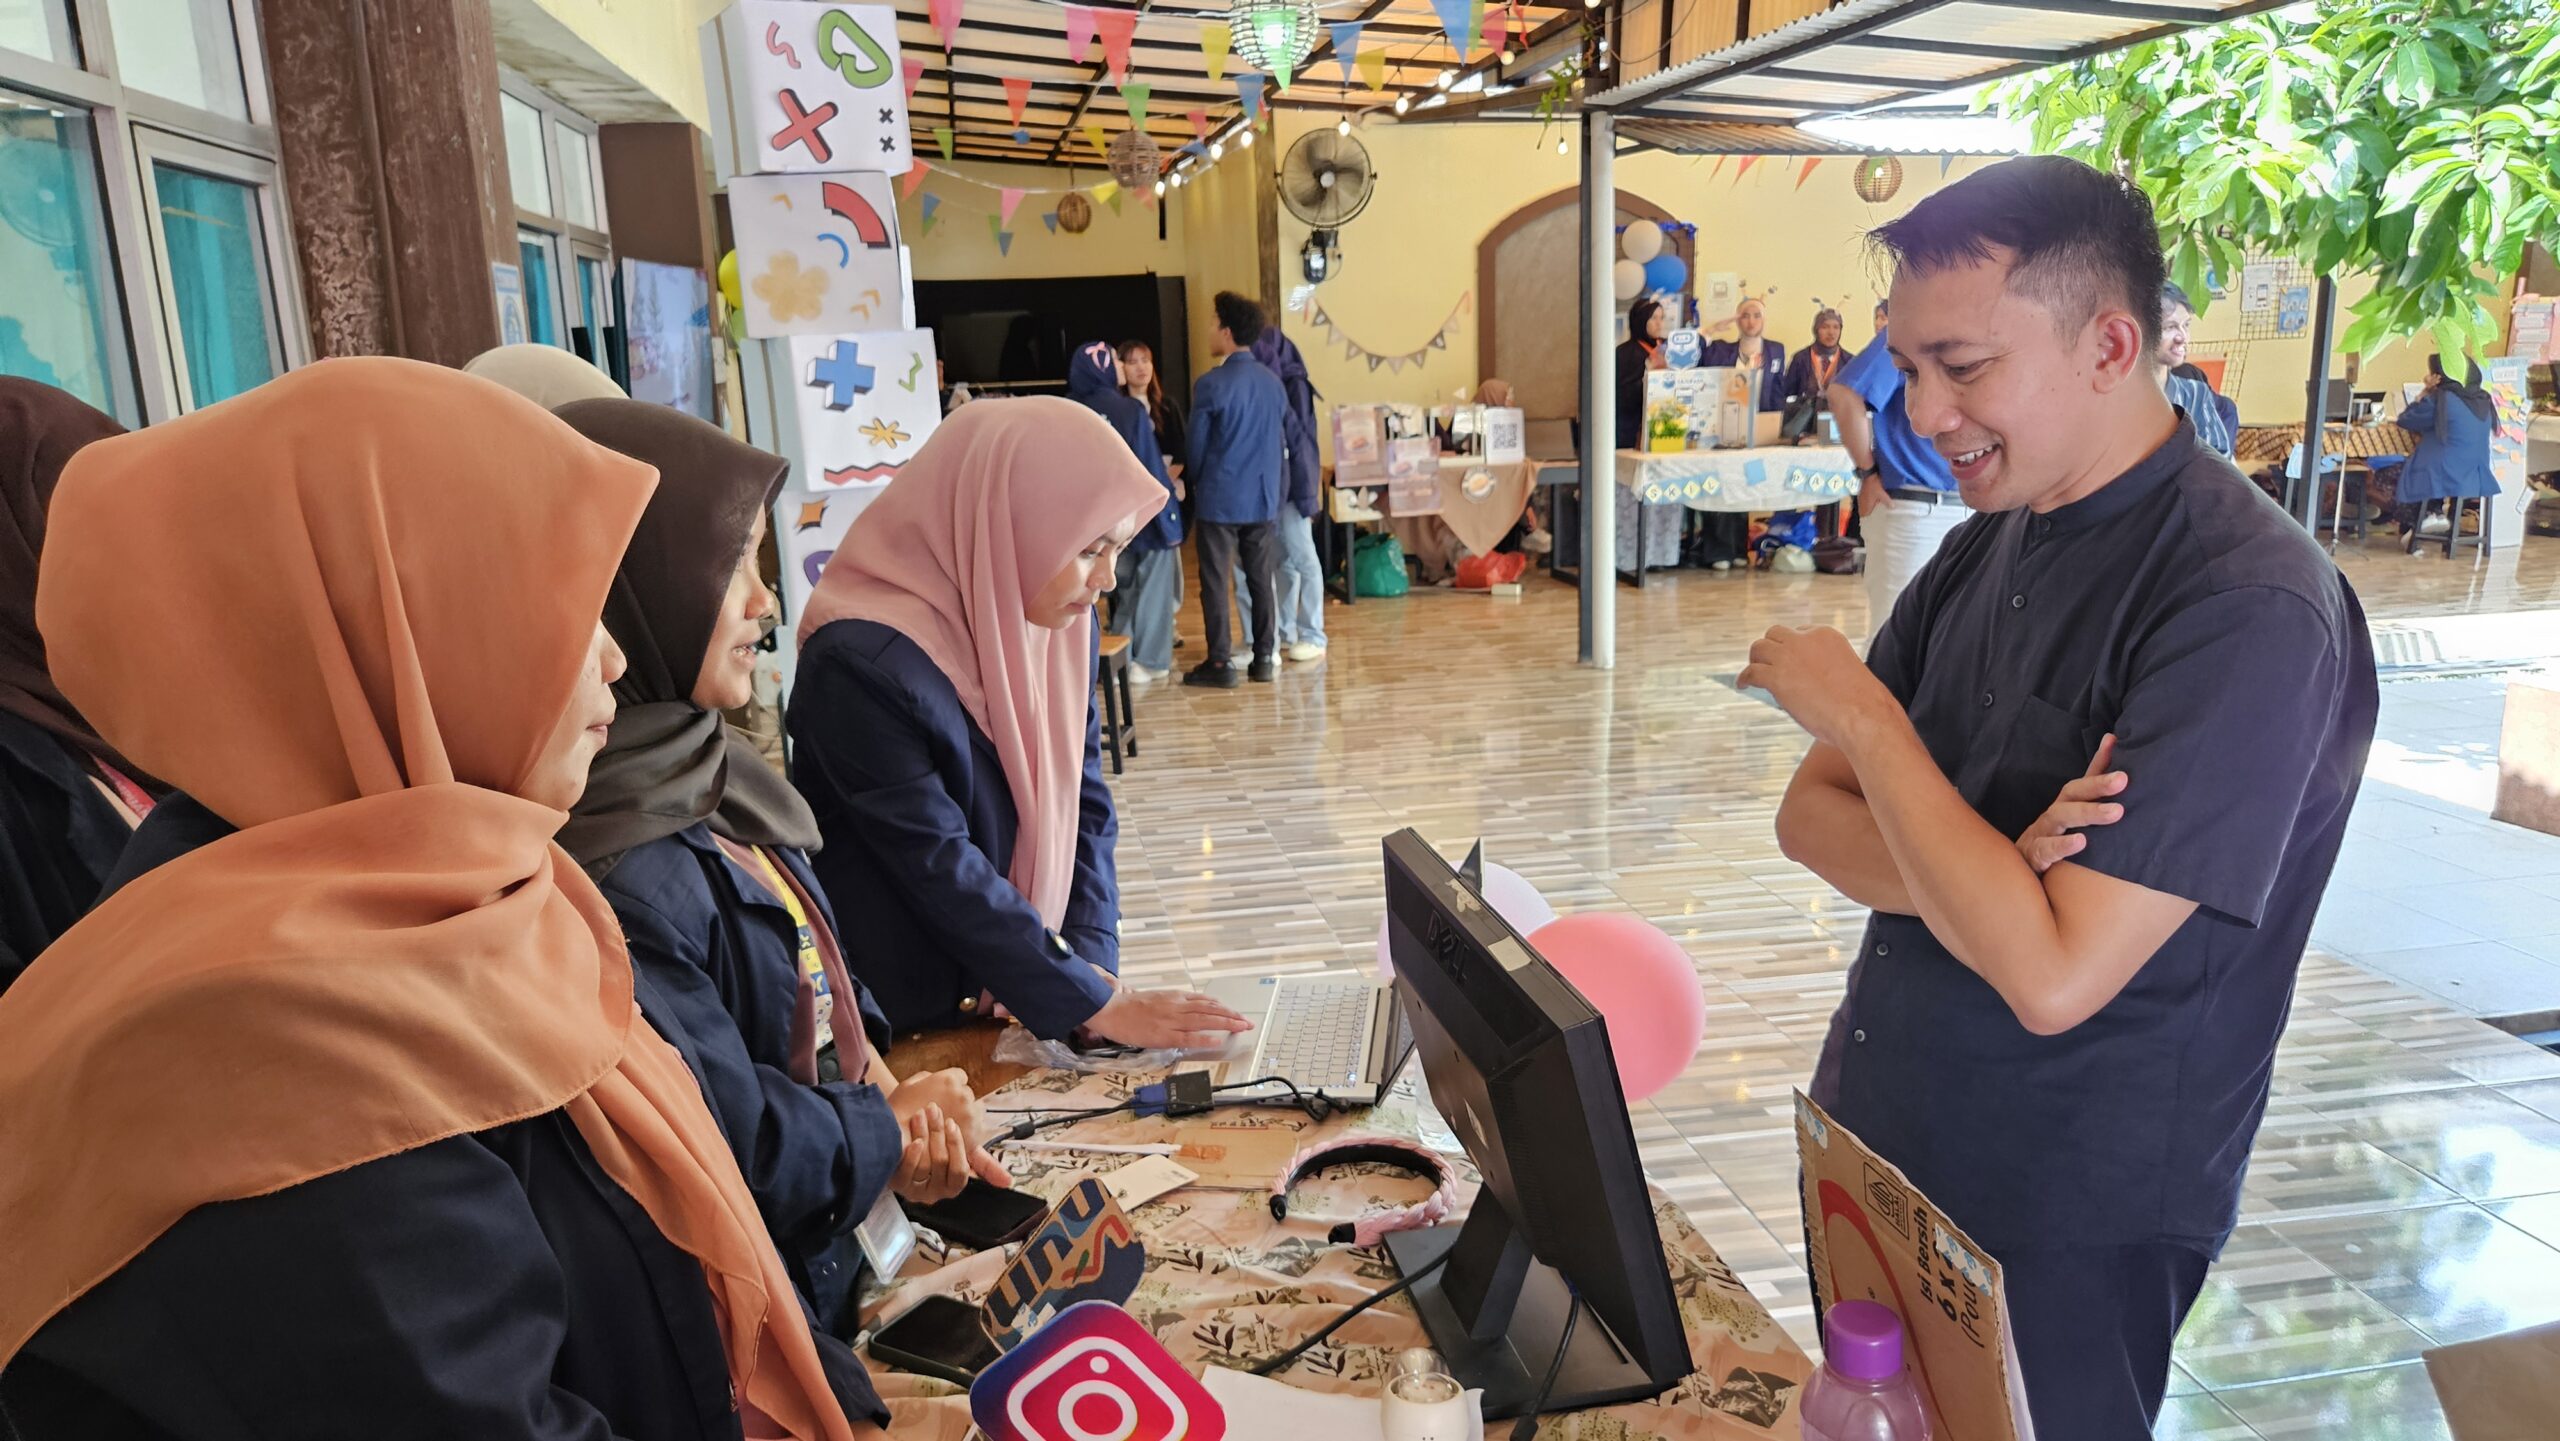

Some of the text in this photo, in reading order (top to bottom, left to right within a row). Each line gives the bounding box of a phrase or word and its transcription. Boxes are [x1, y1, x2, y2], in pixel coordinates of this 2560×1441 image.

[1425, 909, 1470, 982] DELL
[1914, 1206, 1934, 1304] Isi Bersih
[1937, 1294, 1957, 1322] 6
